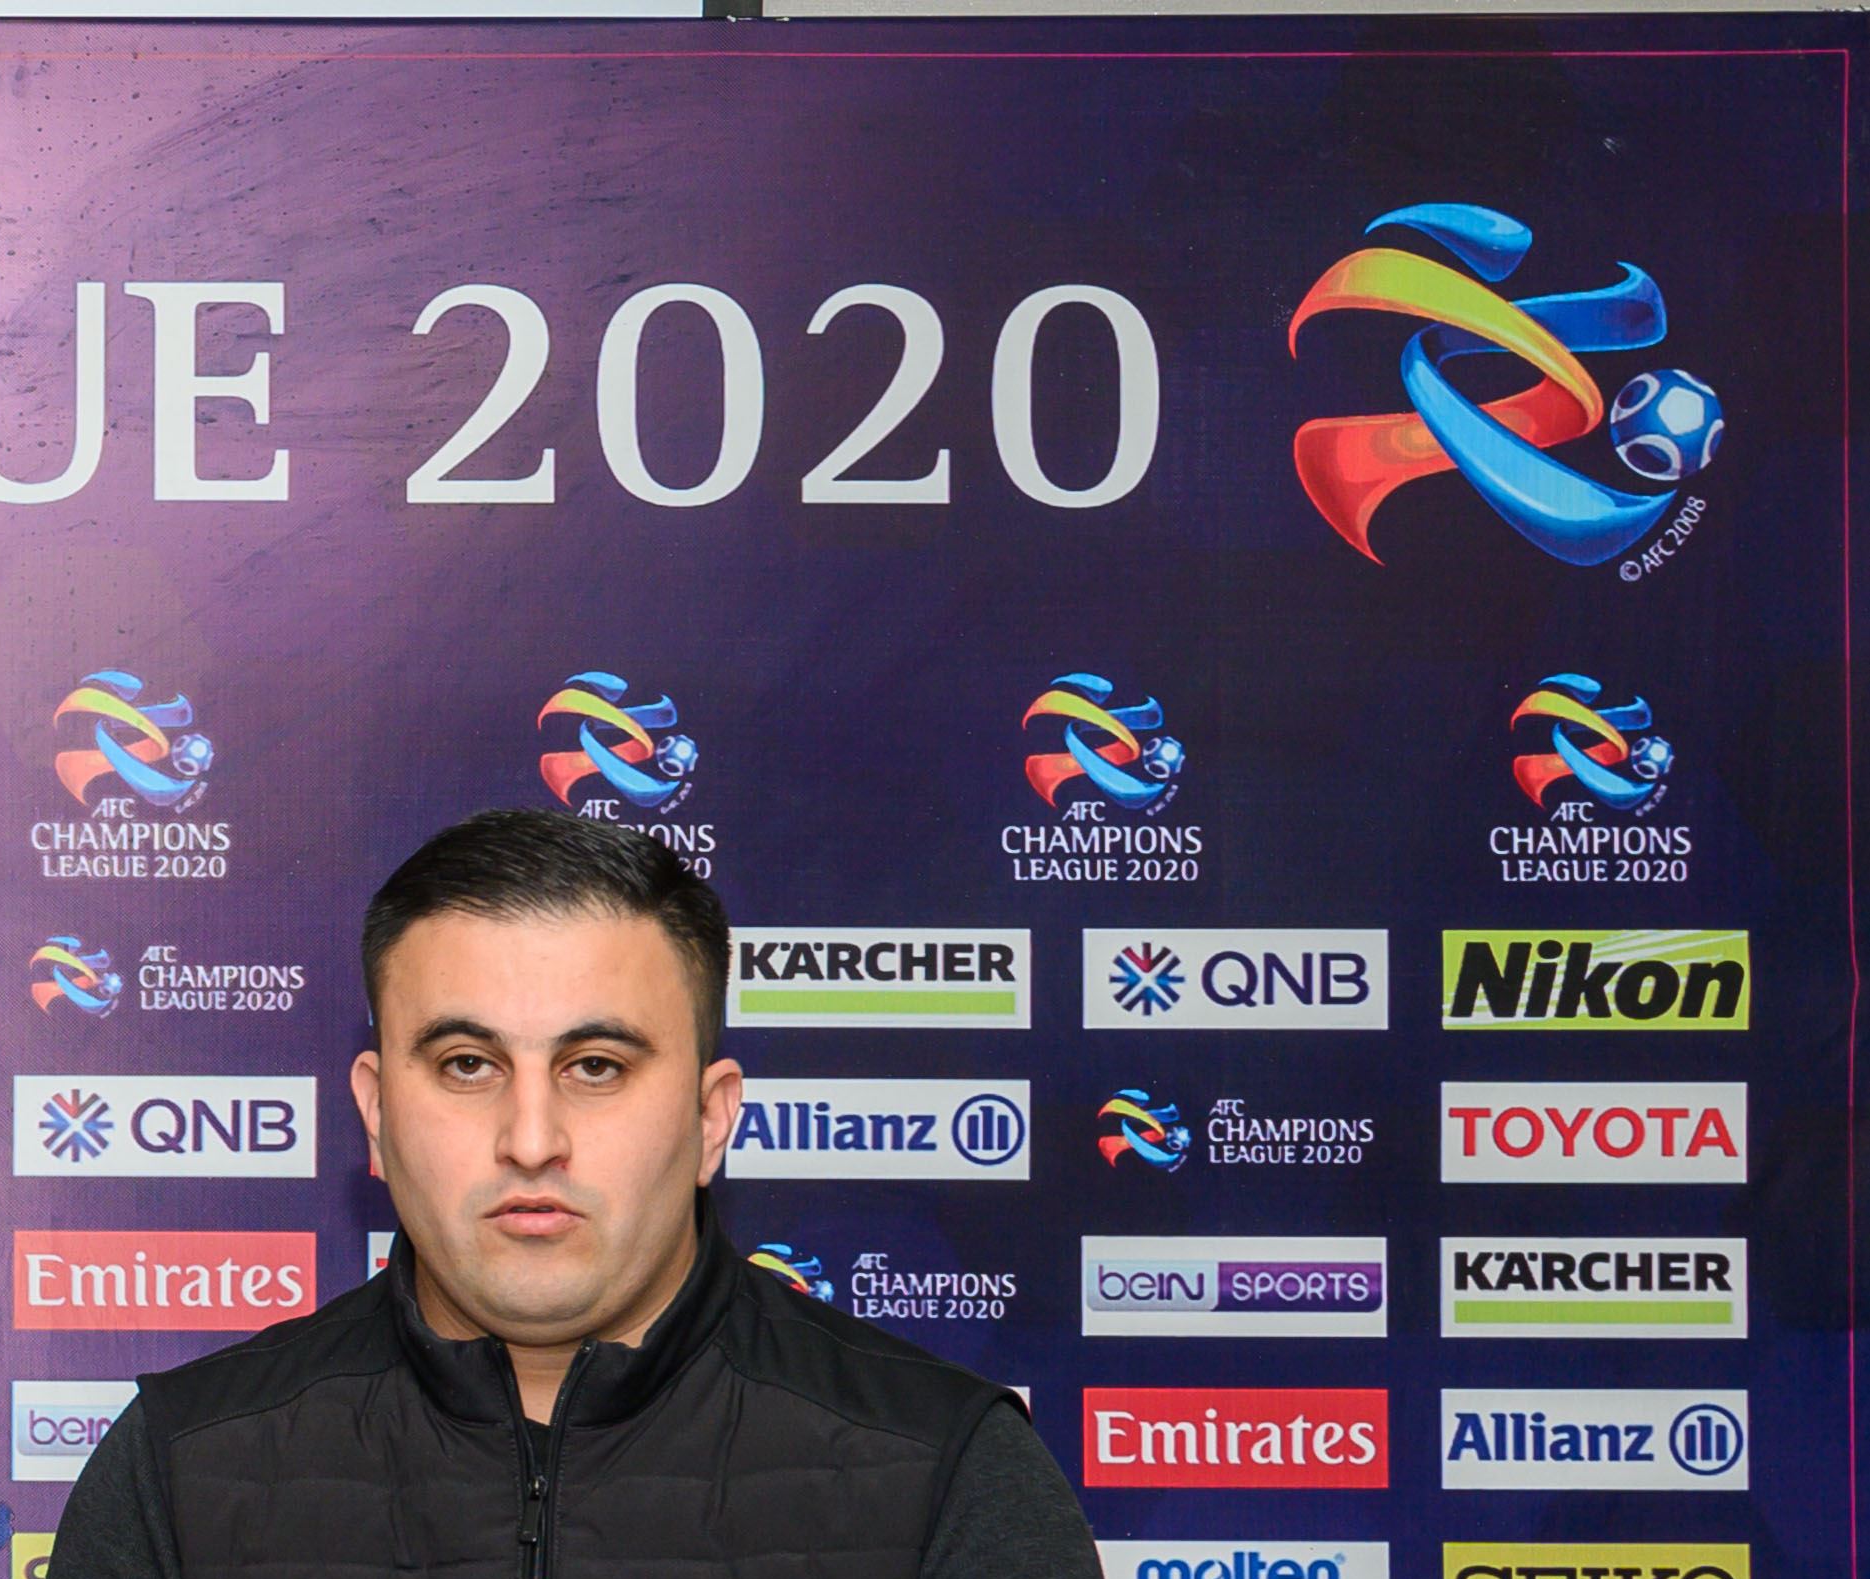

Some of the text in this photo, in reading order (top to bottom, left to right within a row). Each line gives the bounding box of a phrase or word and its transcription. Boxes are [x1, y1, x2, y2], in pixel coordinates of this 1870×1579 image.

[406, 284, 1159, 508] 2020
[92, 798, 134, 818] AFC
[578, 800, 619, 820] AFC
[1063, 801, 1105, 821] AFC
[1551, 802, 1593, 822] AFC
[31, 823, 230, 850] CHAMPIONS
[1002, 826, 1201, 854] CHAMPIONS
[1490, 827, 1691, 854] CHAMPIONS
[43, 855, 226, 878] LEAGUE 2020
[1014, 859, 1198, 881] LEAGUE 2020
[1502, 860, 1687, 881] LEAGUE 2020
[140, 946, 177, 962] AFC
[740, 942, 1015, 981] KÄRCHER
[139, 965, 304, 988] CHAMPIONS
[1202, 951, 1369, 1007] QNB
[1449, 941, 1745, 1019] Nikon
[140, 990, 292, 1011] LEAGUE 2020
[1210, 1099, 1244, 1116] AFC
[131, 1099, 296, 1153] QNB
[731, 1102, 937, 1151] Allianz
[1208, 1118, 1373, 1142] CHAMPIONS
[1449, 1107, 1738, 1158] TOYOTA
[1209, 1145, 1361, 1163] LEAGUE 2020
[853, 1253, 888, 1270] AFC
[1455, 1252, 1732, 1291] KÄRCHER
[25, 1252, 302, 1306] Emirates
[852, 1273, 1016, 1297] CHAMPIONS
[1232, 1272, 1368, 1301] SPORTS
[853, 1299, 1004, 1318] LEAGUE 2020
[1094, 1409, 1375, 1464] Emirates
[1448, 1412, 1654, 1461] Allianz
